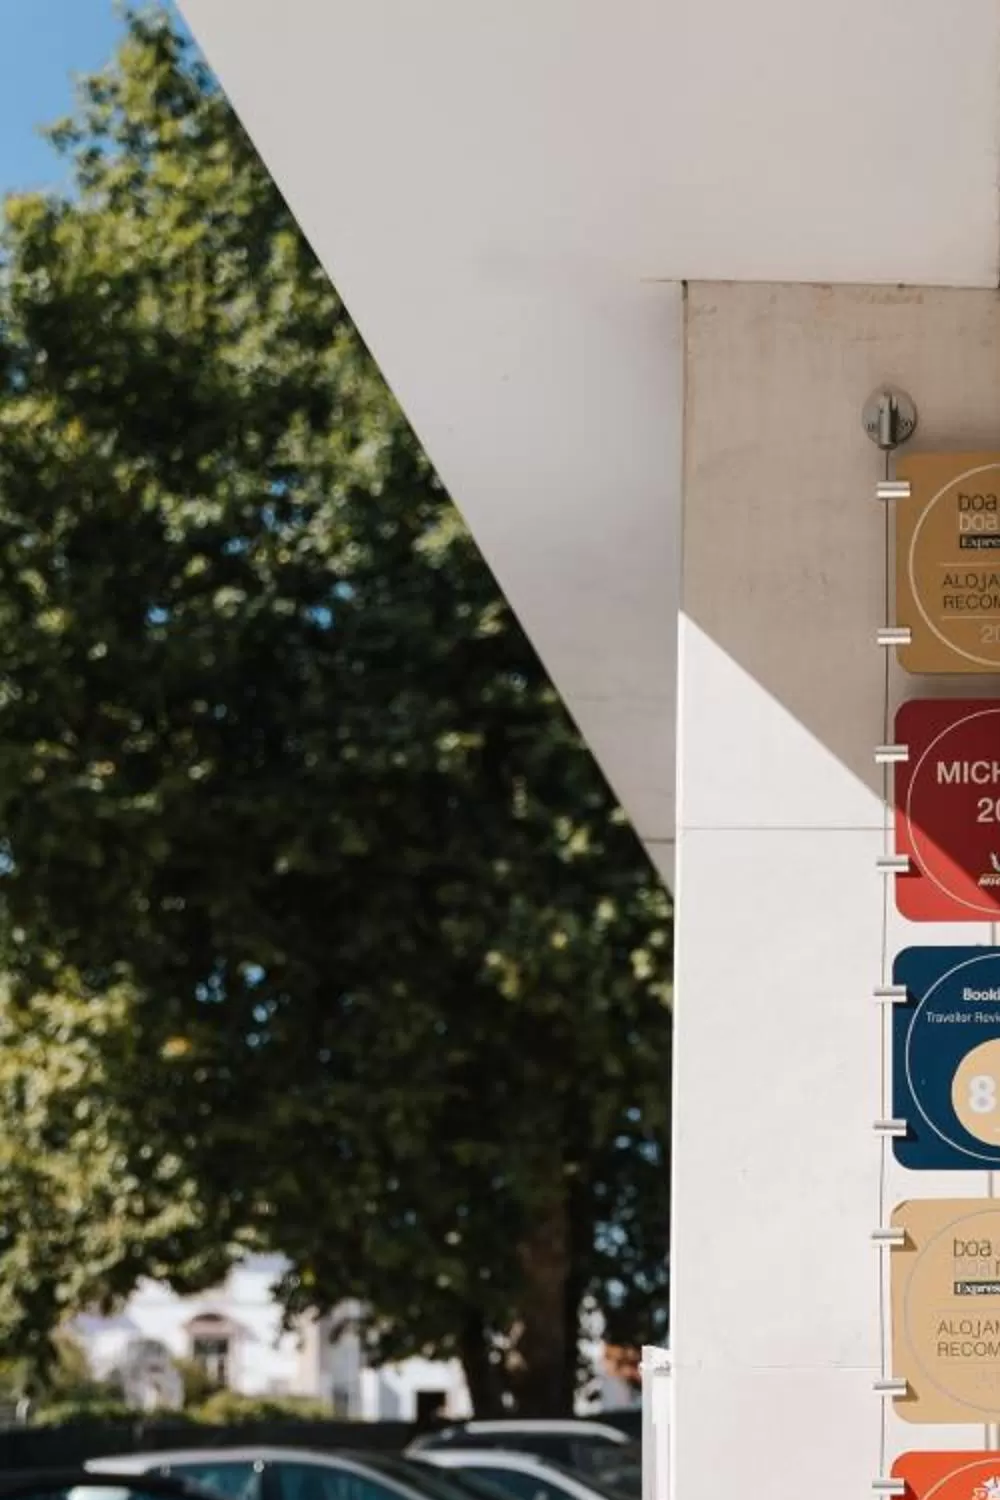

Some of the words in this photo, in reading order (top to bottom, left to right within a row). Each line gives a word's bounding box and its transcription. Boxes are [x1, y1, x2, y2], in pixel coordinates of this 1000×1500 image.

[958, 492, 997, 512] boa
[959, 512, 998, 531] boa
[953, 1237, 992, 1257] boa
